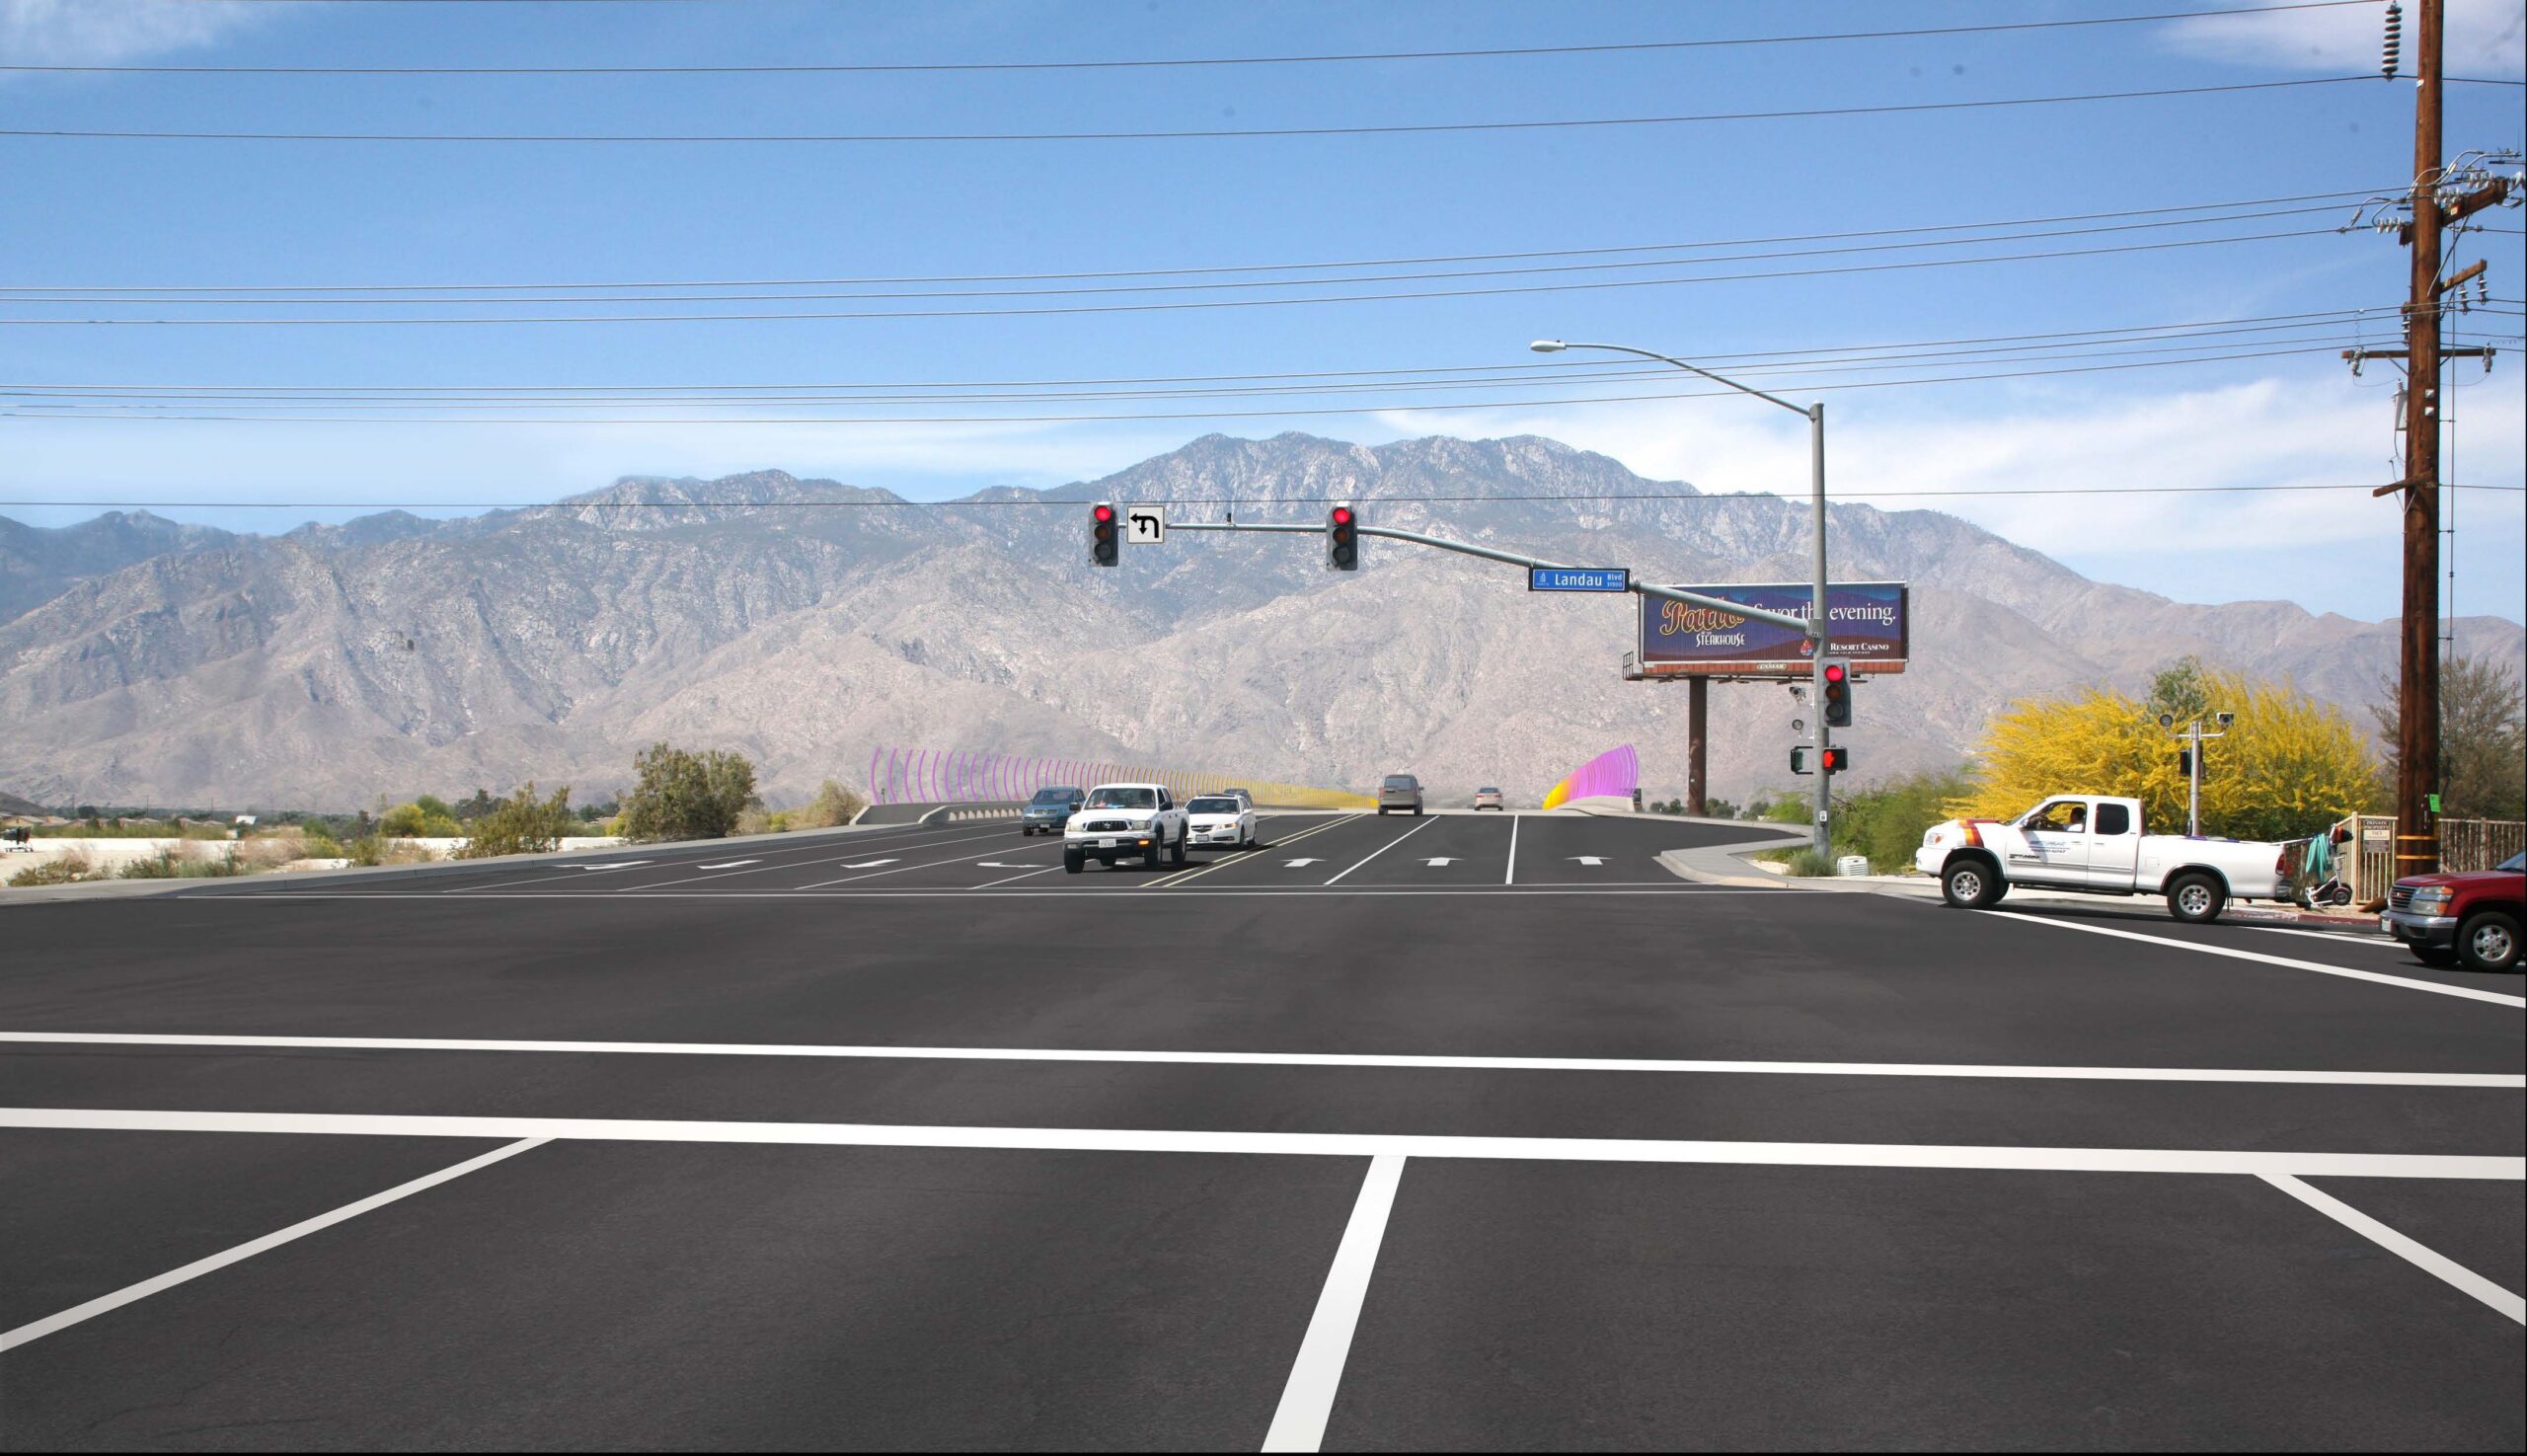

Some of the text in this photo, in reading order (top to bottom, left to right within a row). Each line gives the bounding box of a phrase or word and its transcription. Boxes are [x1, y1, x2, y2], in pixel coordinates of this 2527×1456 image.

[1555, 574, 1602, 586] Landau
[1607, 573, 1623, 581] Blvd
[1829, 602, 1896, 626] evening.
[1696, 633, 1746, 648] STEAKHOUSE
[1830, 643, 1889, 651] RESORT CASINO
